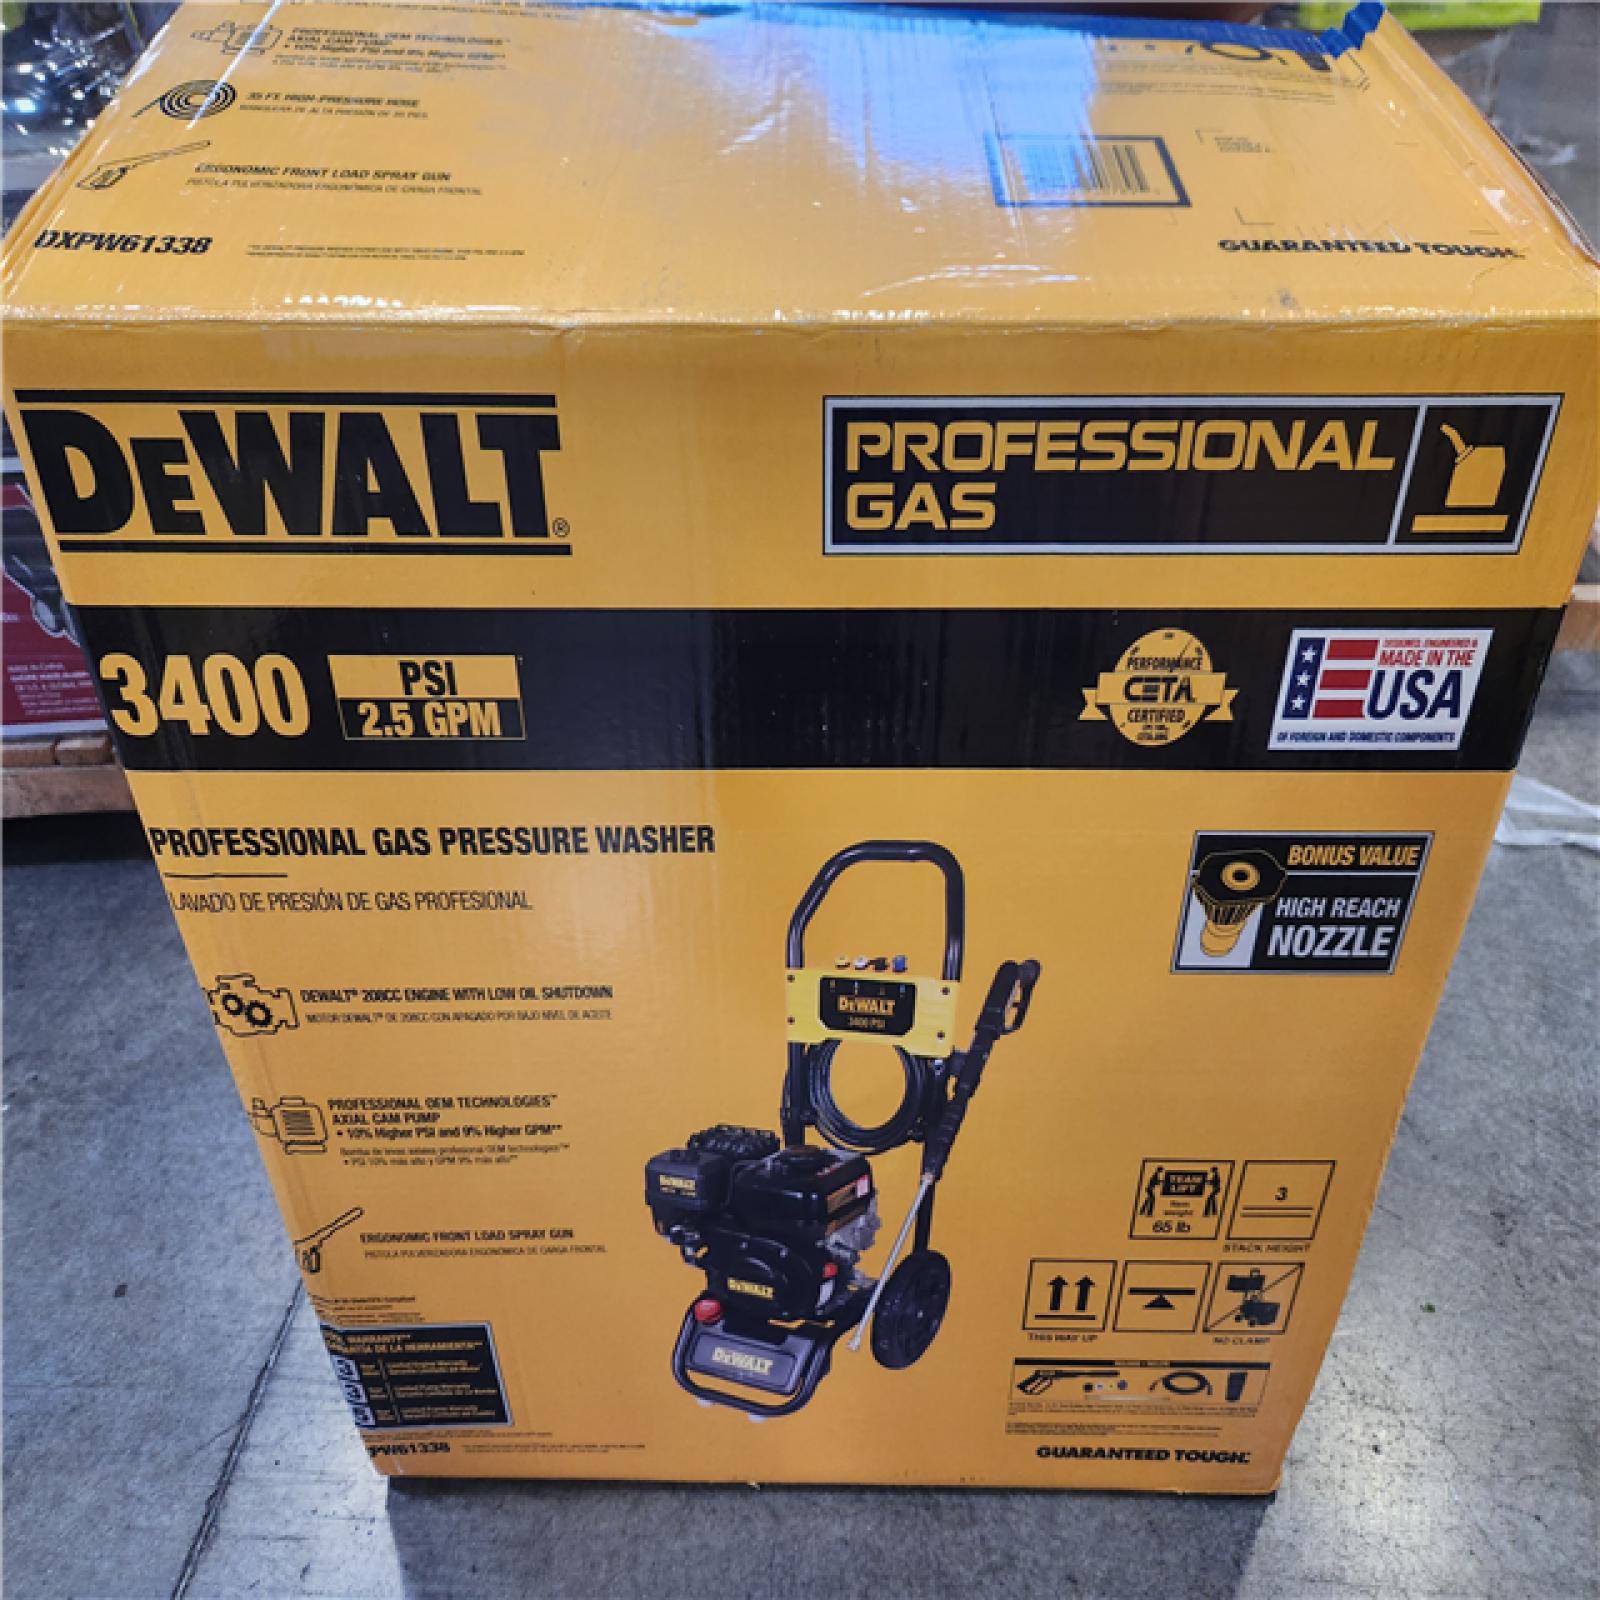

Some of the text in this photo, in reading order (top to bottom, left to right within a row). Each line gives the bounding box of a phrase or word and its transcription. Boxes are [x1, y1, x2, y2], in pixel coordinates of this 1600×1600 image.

[282, 167, 328, 178] FRONT
[331, 168, 371, 178] LOAD
[372, 169, 419, 180] SPRAY
[421, 172, 452, 181] GUN
[34, 230, 213, 255] DXPW61338
[1217, 240, 1411, 252] GUARANTEED
[846, 420, 1395, 472] PROFESSIONAL
[846, 482, 997, 532] GAS
[1127, 656, 1203, 671] PERFORMANCE
[1377, 649, 1476, 666] MADE IN THE
[400, 660, 457, 697] PSI
[100, 652, 310, 737] 3400
[1366, 669, 1463, 720] USA
[358, 701, 502, 738] 2.5 GPM
[1127, 709, 1186, 723] CERTIFIED
[1277, 731, 1456, 743] OF FOREIGN AND DOMESTIC COMPONENTS
[149, 824, 716, 857] PROFESSIONAL GAS PRESSURE WASHER
[1287, 844, 1421, 866] BONUS VALUE
[240, 891, 262, 911] DE
[267, 888, 342, 911] PRESIÓN
[346, 891, 372, 911] DE
[375, 891, 411, 911] GAS
[415, 889, 535, 911] PROFESIONAL
[1275, 897, 1401, 918] HIGH REACH
[1267, 924, 1396, 959] NOZZLE
[404, 987, 450, 1002] ENGINE
[452, 986, 486, 1001] WITH
[487, 986, 515, 1000] LOW
[519, 986, 541, 1000] OIL
[542, 985, 613, 998] SHUTDOWN
[328, 1097, 422, 1110] PROFESSIONAL
[425, 1096, 454, 1109] OEM
[332, 1111, 440, 1125] AXIAL CAM PUMP
[347, 1128, 373, 1139] 10%
[375, 1127, 413, 1140] Higher
[415, 1127, 436, 1138] PSI
[440, 1126, 460, 1138] and
[485, 1124, 521, 1138] Higher
[1274, 1186, 1288, 1201] 3
[360, 1228, 574, 1243] ERGONOMIC FRONT LOAD SPRAY GUN
[1080, 1333, 1098, 1343] UP
[1036, 1446, 1170, 1461] GUARANTEED
